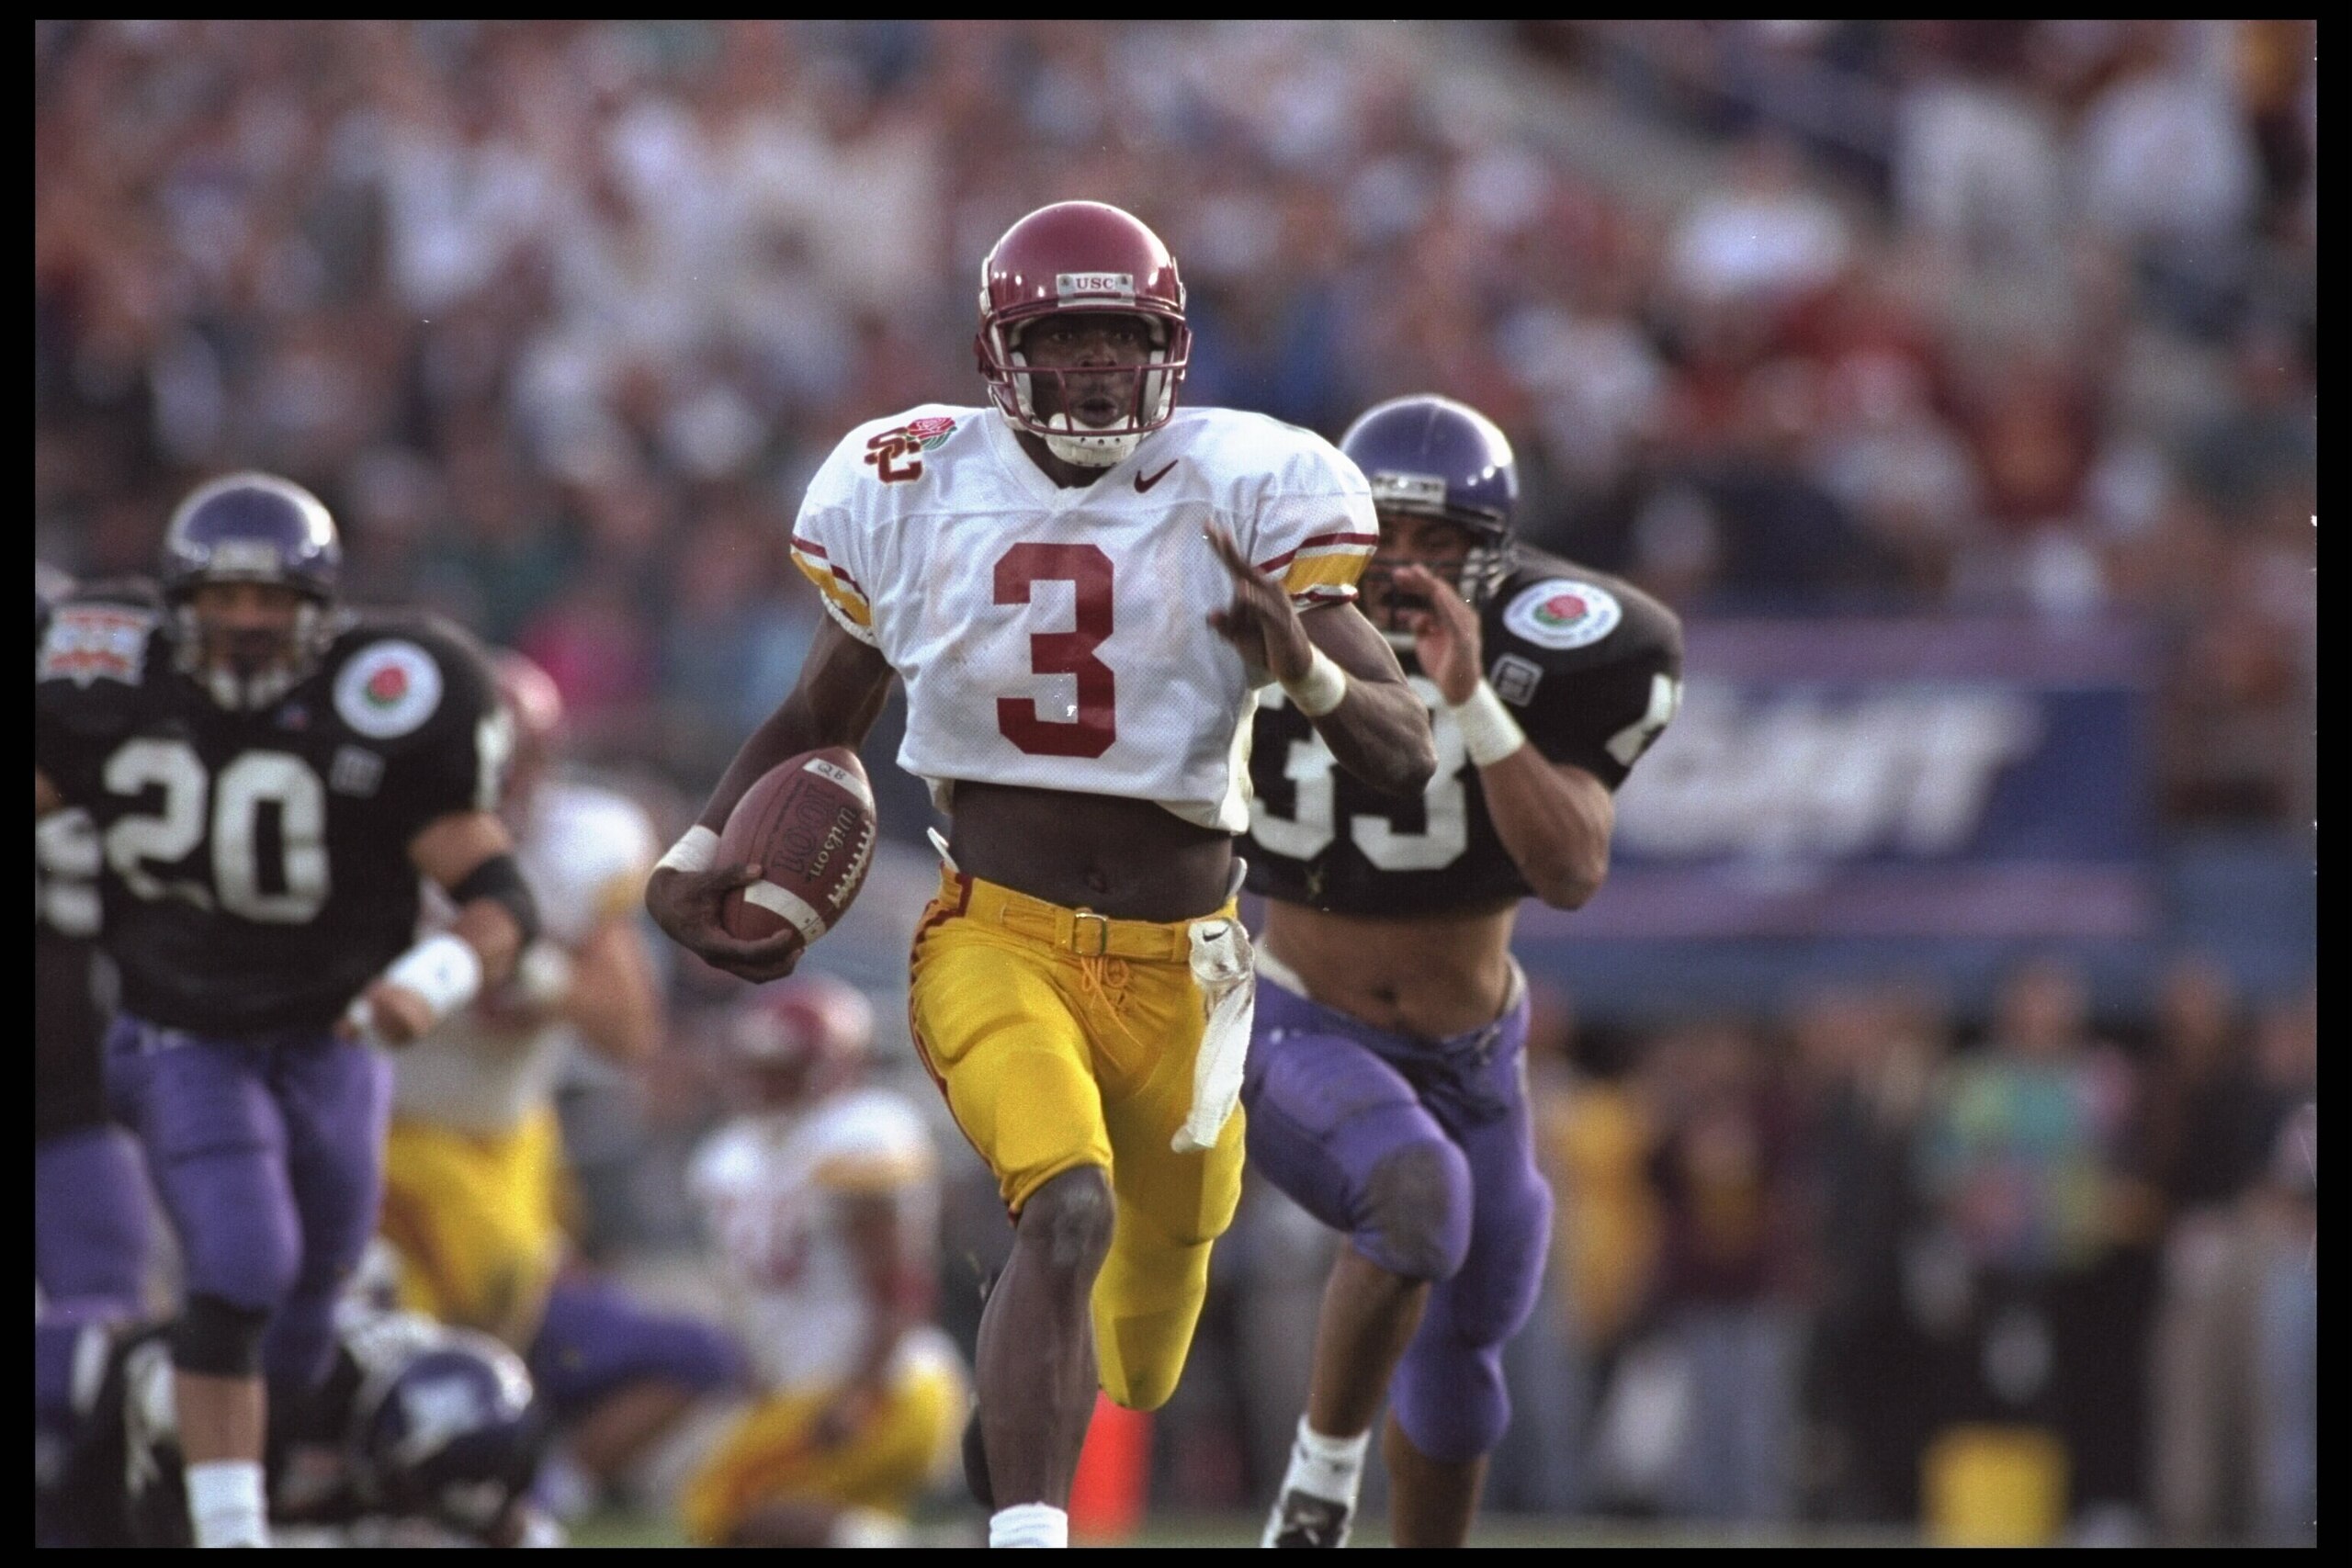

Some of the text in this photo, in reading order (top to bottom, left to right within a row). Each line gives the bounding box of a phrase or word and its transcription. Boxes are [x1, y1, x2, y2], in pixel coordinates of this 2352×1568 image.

[1076, 277, 1114, 289] USC
[993, 542, 1116, 759] 3
[101, 737, 331, 924] 20
[808, 807, 858, 877] Wilson
